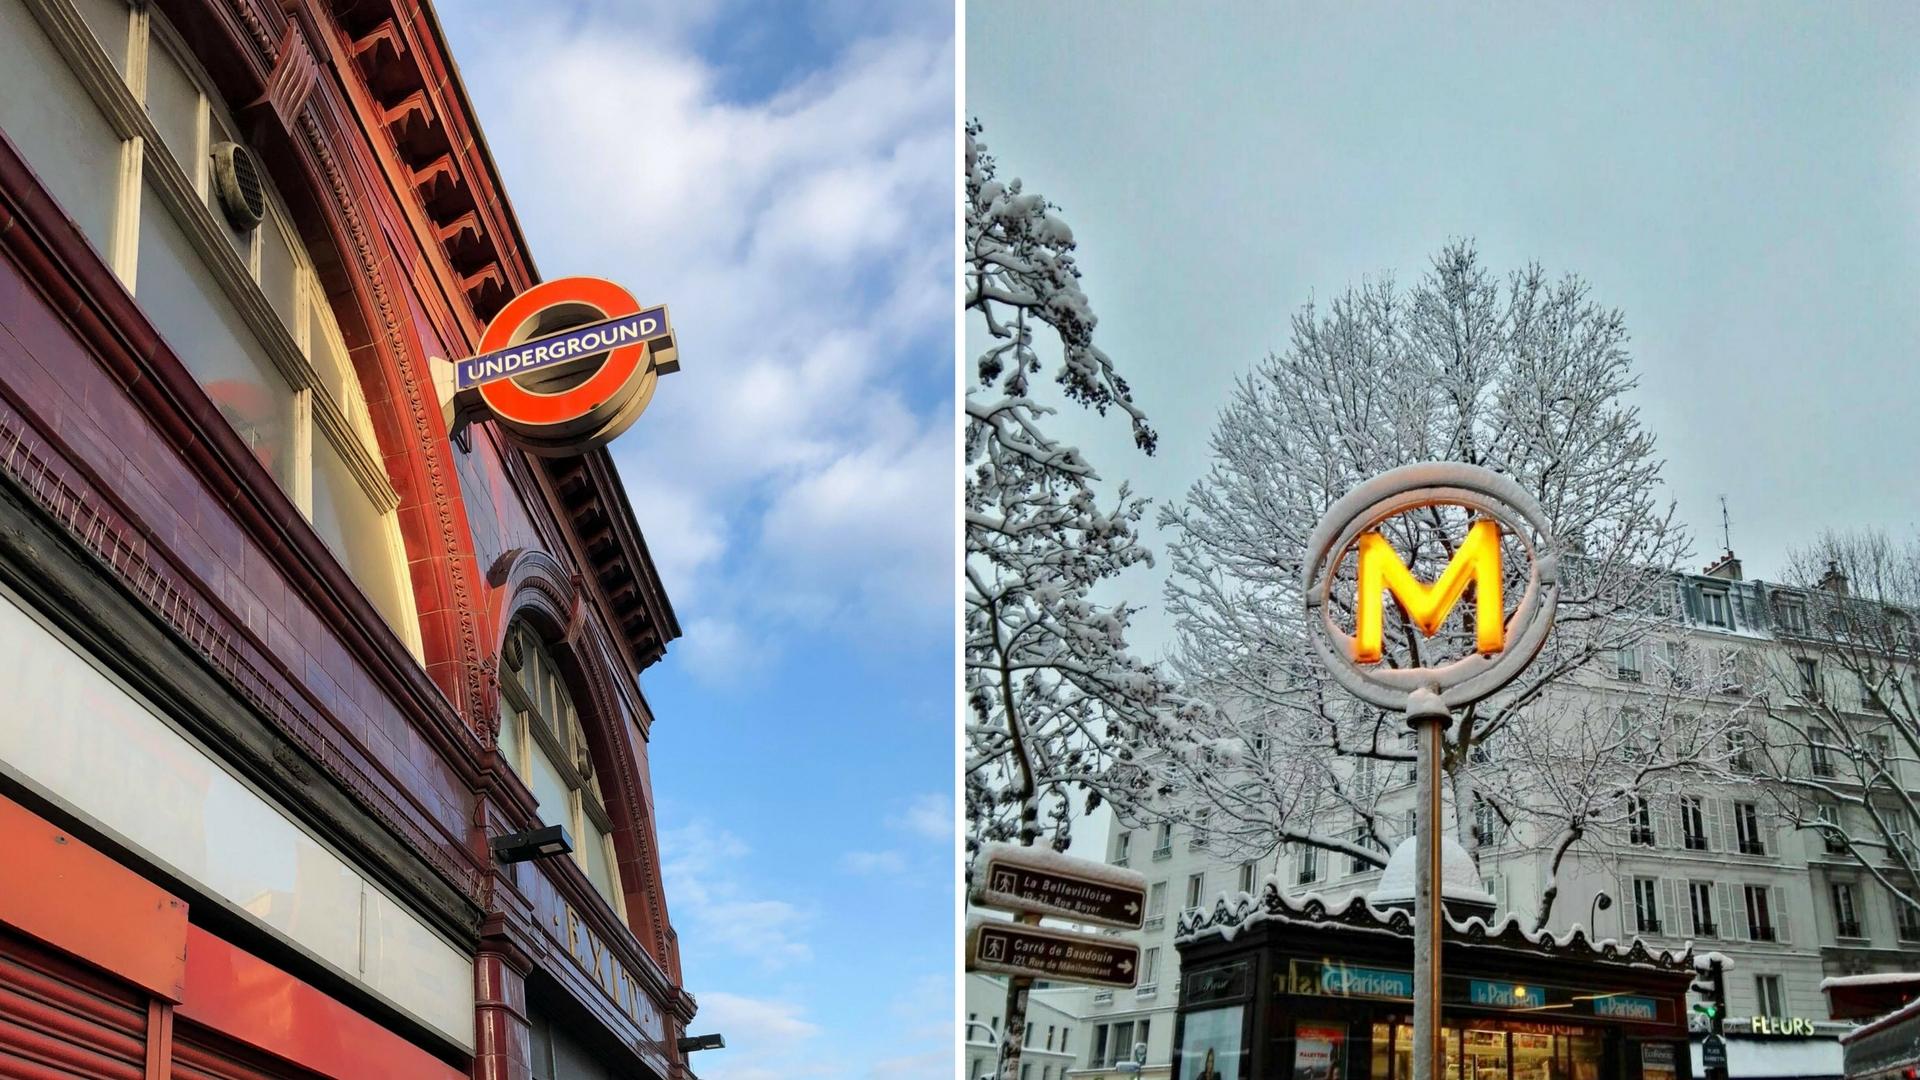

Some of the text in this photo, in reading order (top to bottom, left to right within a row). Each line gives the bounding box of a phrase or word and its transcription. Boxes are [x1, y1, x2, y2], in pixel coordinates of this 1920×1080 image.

[468, 318, 657, 381] UNDERGROUND
[1355, 518, 1504, 664] M
[1024, 876, 1112, 903] La Bellevilloise
[1055, 897, 1071, 909] Rue
[1075, 901, 1101, 914] Boyer
[565, 901, 638, 1021] EXIT
[1014, 938, 1113, 963] Carré de Baudouin
[1029, 957, 1045, 968] Rue
[1047, 959, 1057, 969] de
[1342, 970, 1404, 995] Parisien
[1488, 983, 1539, 1008] Parisien
[1608, 998, 1652, 1018] Parisien
[1752, 1016, 1815, 1036] FLEURS
